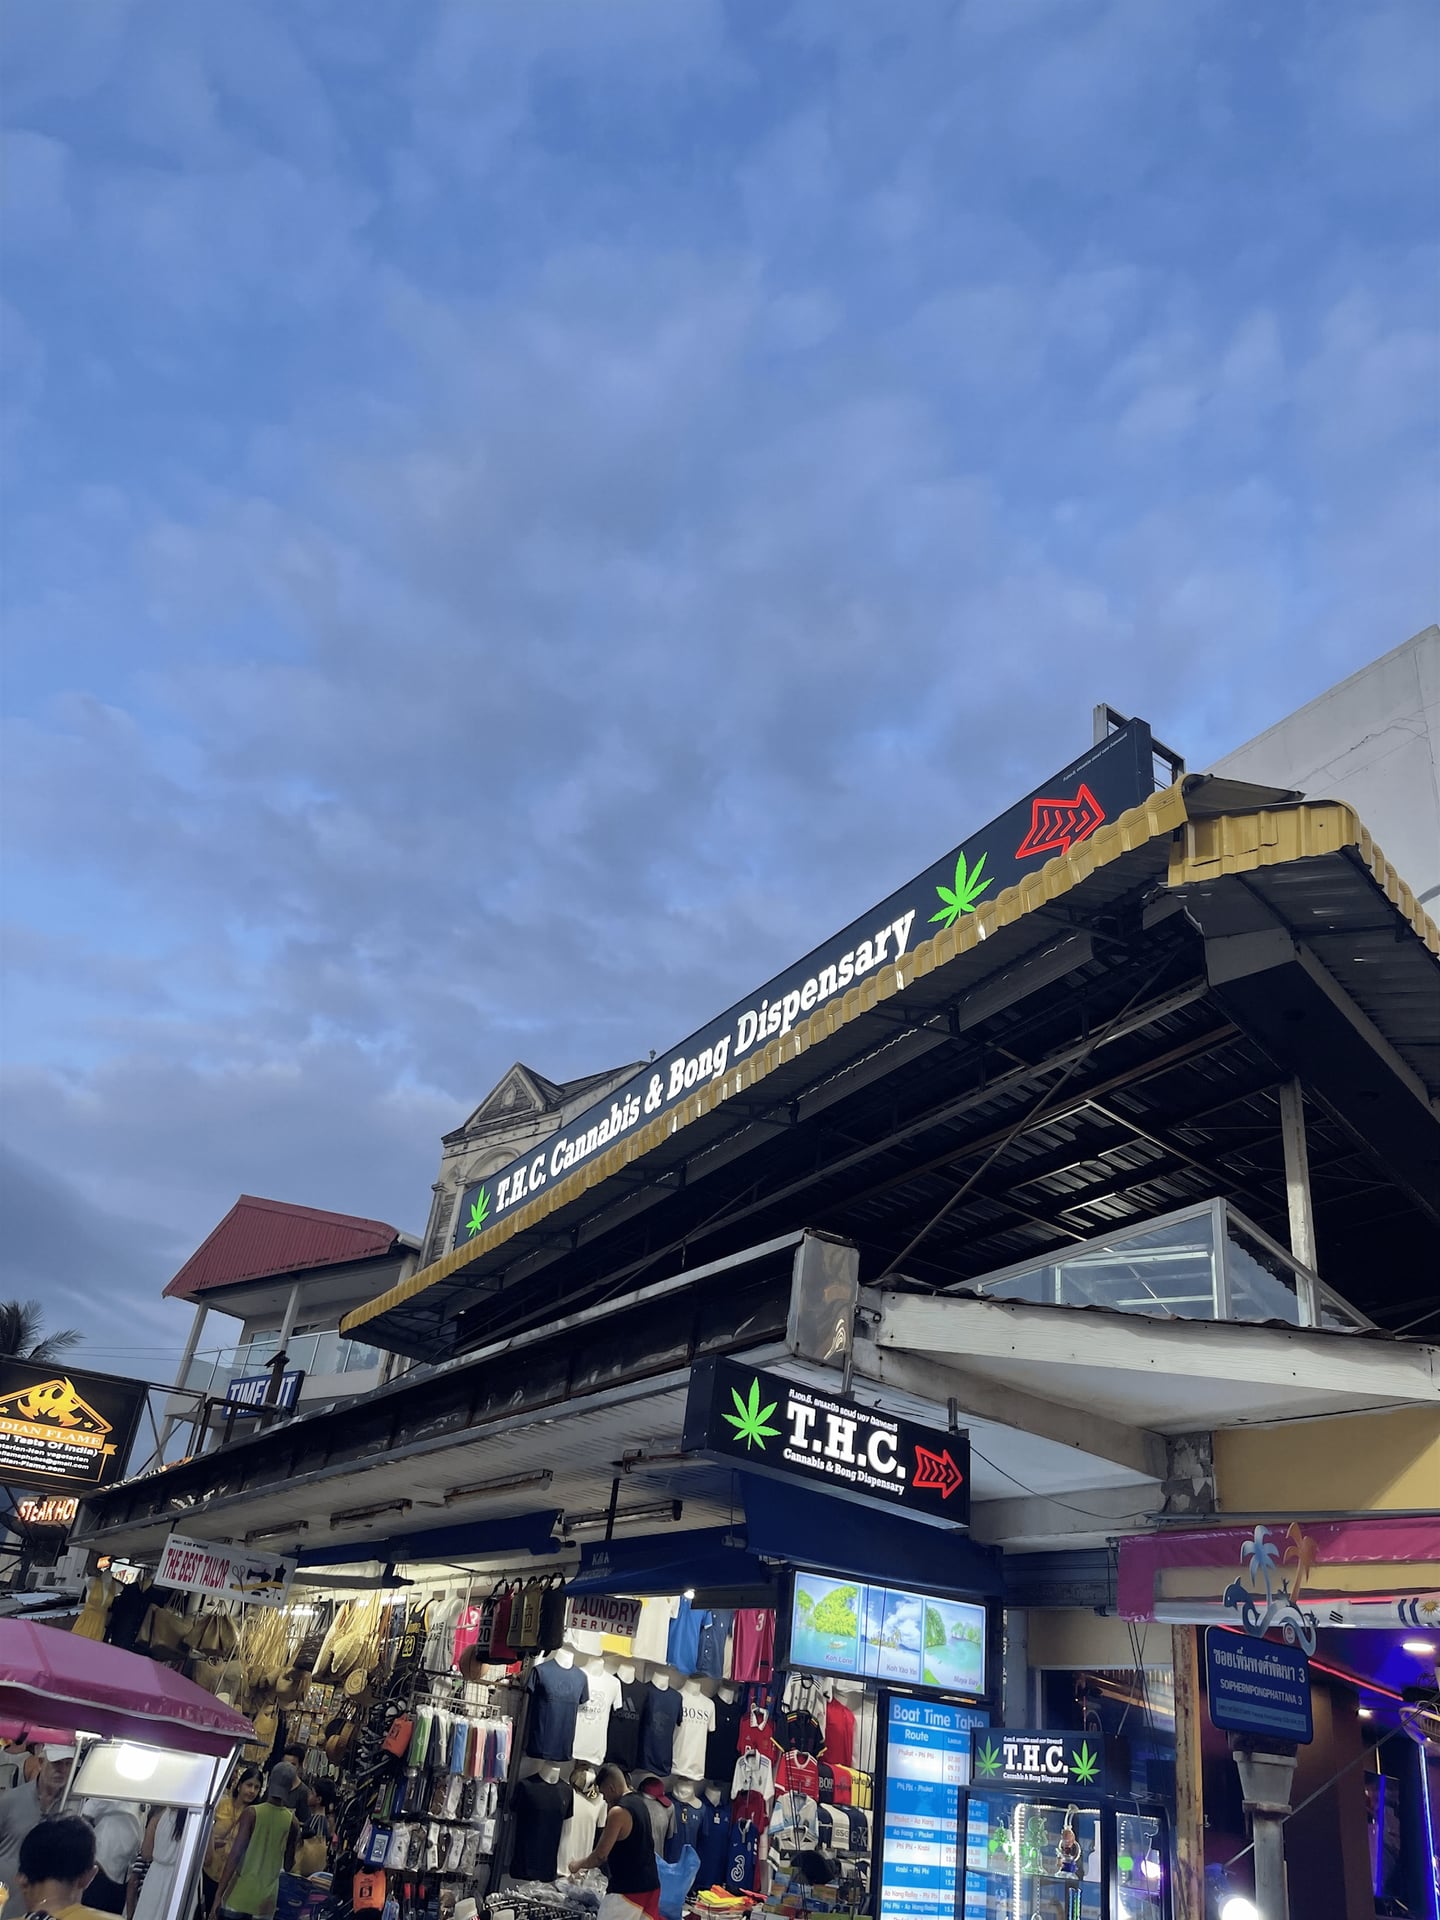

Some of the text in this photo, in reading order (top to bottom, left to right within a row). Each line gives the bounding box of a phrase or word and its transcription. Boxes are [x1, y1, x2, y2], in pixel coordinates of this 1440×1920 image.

[495, 909, 916, 1213] T.H.C. Cannabis & Bong Dispensary
[14, 1435, 45, 1448] Taste
[47, 1442, 64, 1450] Of
[64, 1443, 98, 1457] India)
[46, 1430, 101, 1446] FLAME
[786, 1400, 906, 1479] T.H.C.
[47, 1452, 89, 1463] vegetarian
[783, 1447, 905, 1495] Cannabis & Bong Dispensary
[162, 1548, 231, 1590] THE BEST TAILOR
[571, 1597, 640, 1623] LAUNDRY
[571, 1617, 634, 1635] SERVICE
[755, 1612, 765, 1632] 3
[886, 1663, 899, 1672] Koh
[1298, 1667, 1305, 1683] 3
[1297, 1696, 1303, 1705] 3
[893, 1704, 920, 1722] Boat
[923, 1708, 951, 1727] Time
[904, 1729, 929, 1742] Route
[1003, 1744, 1069, 1774] T.H.C.
